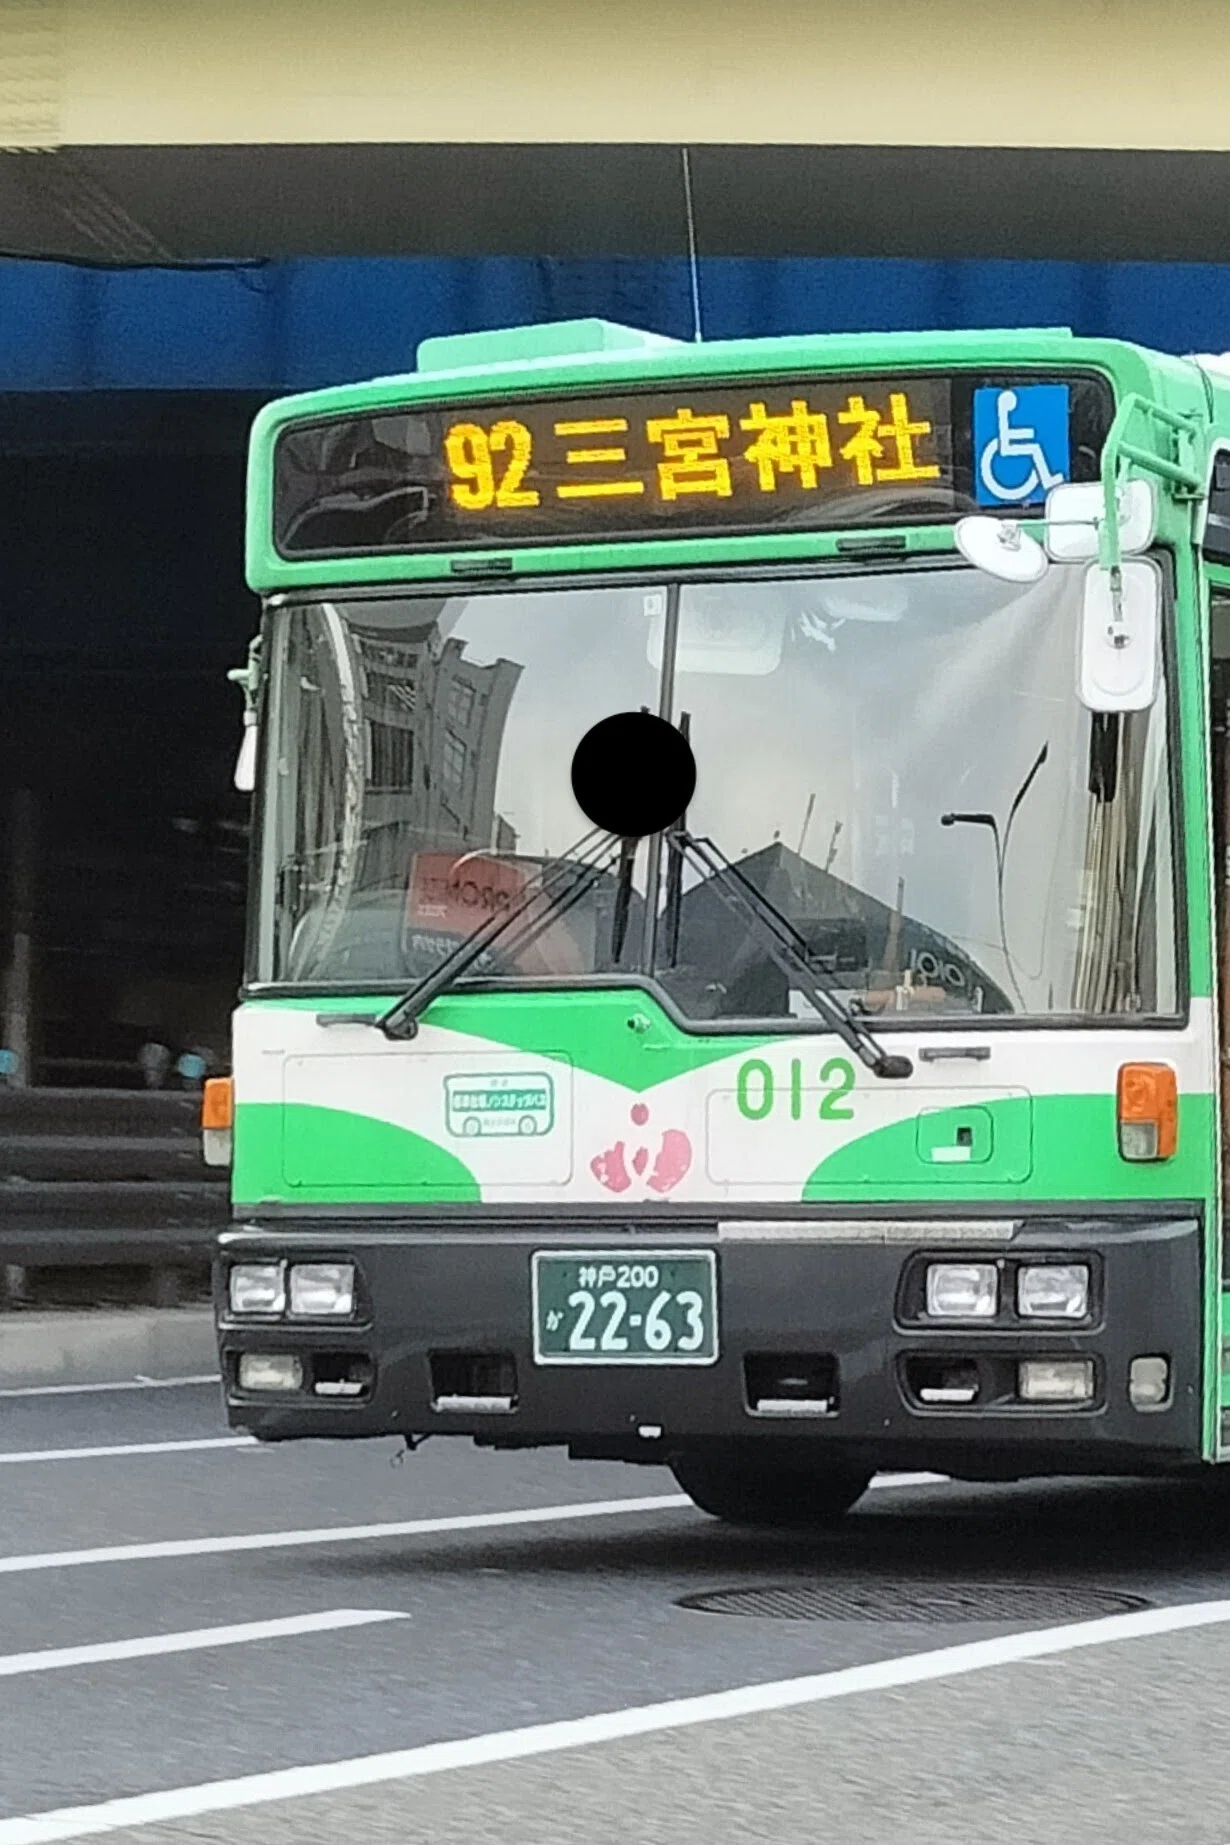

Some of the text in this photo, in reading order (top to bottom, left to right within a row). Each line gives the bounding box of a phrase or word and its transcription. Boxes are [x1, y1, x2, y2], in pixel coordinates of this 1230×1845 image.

[443, 392, 940, 510] 92 三宮神社
[736, 1057, 856, 1121] 012
[568, 1289, 705, 1351] 22-63
